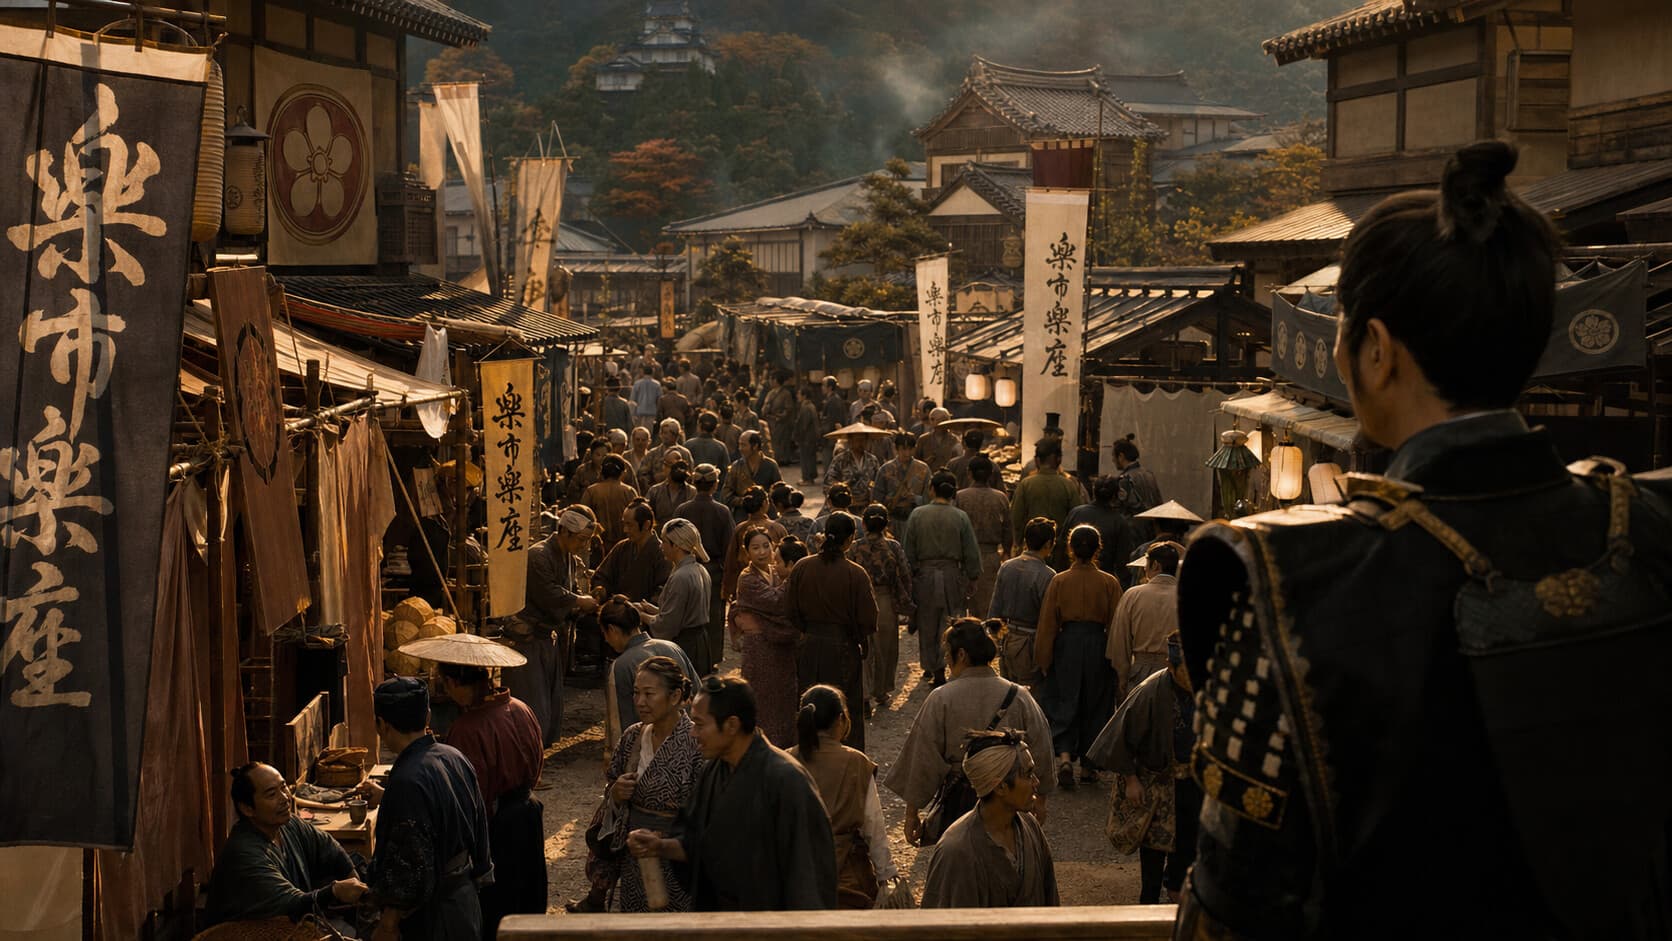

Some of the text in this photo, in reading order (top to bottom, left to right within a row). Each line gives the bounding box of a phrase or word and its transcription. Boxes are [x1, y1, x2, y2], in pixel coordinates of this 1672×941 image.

[1040, 231, 1077, 378] 楽市楽座
[0, 82, 168, 709] 楽市楽座
[492, 382, 526, 553] 楽市楽座
